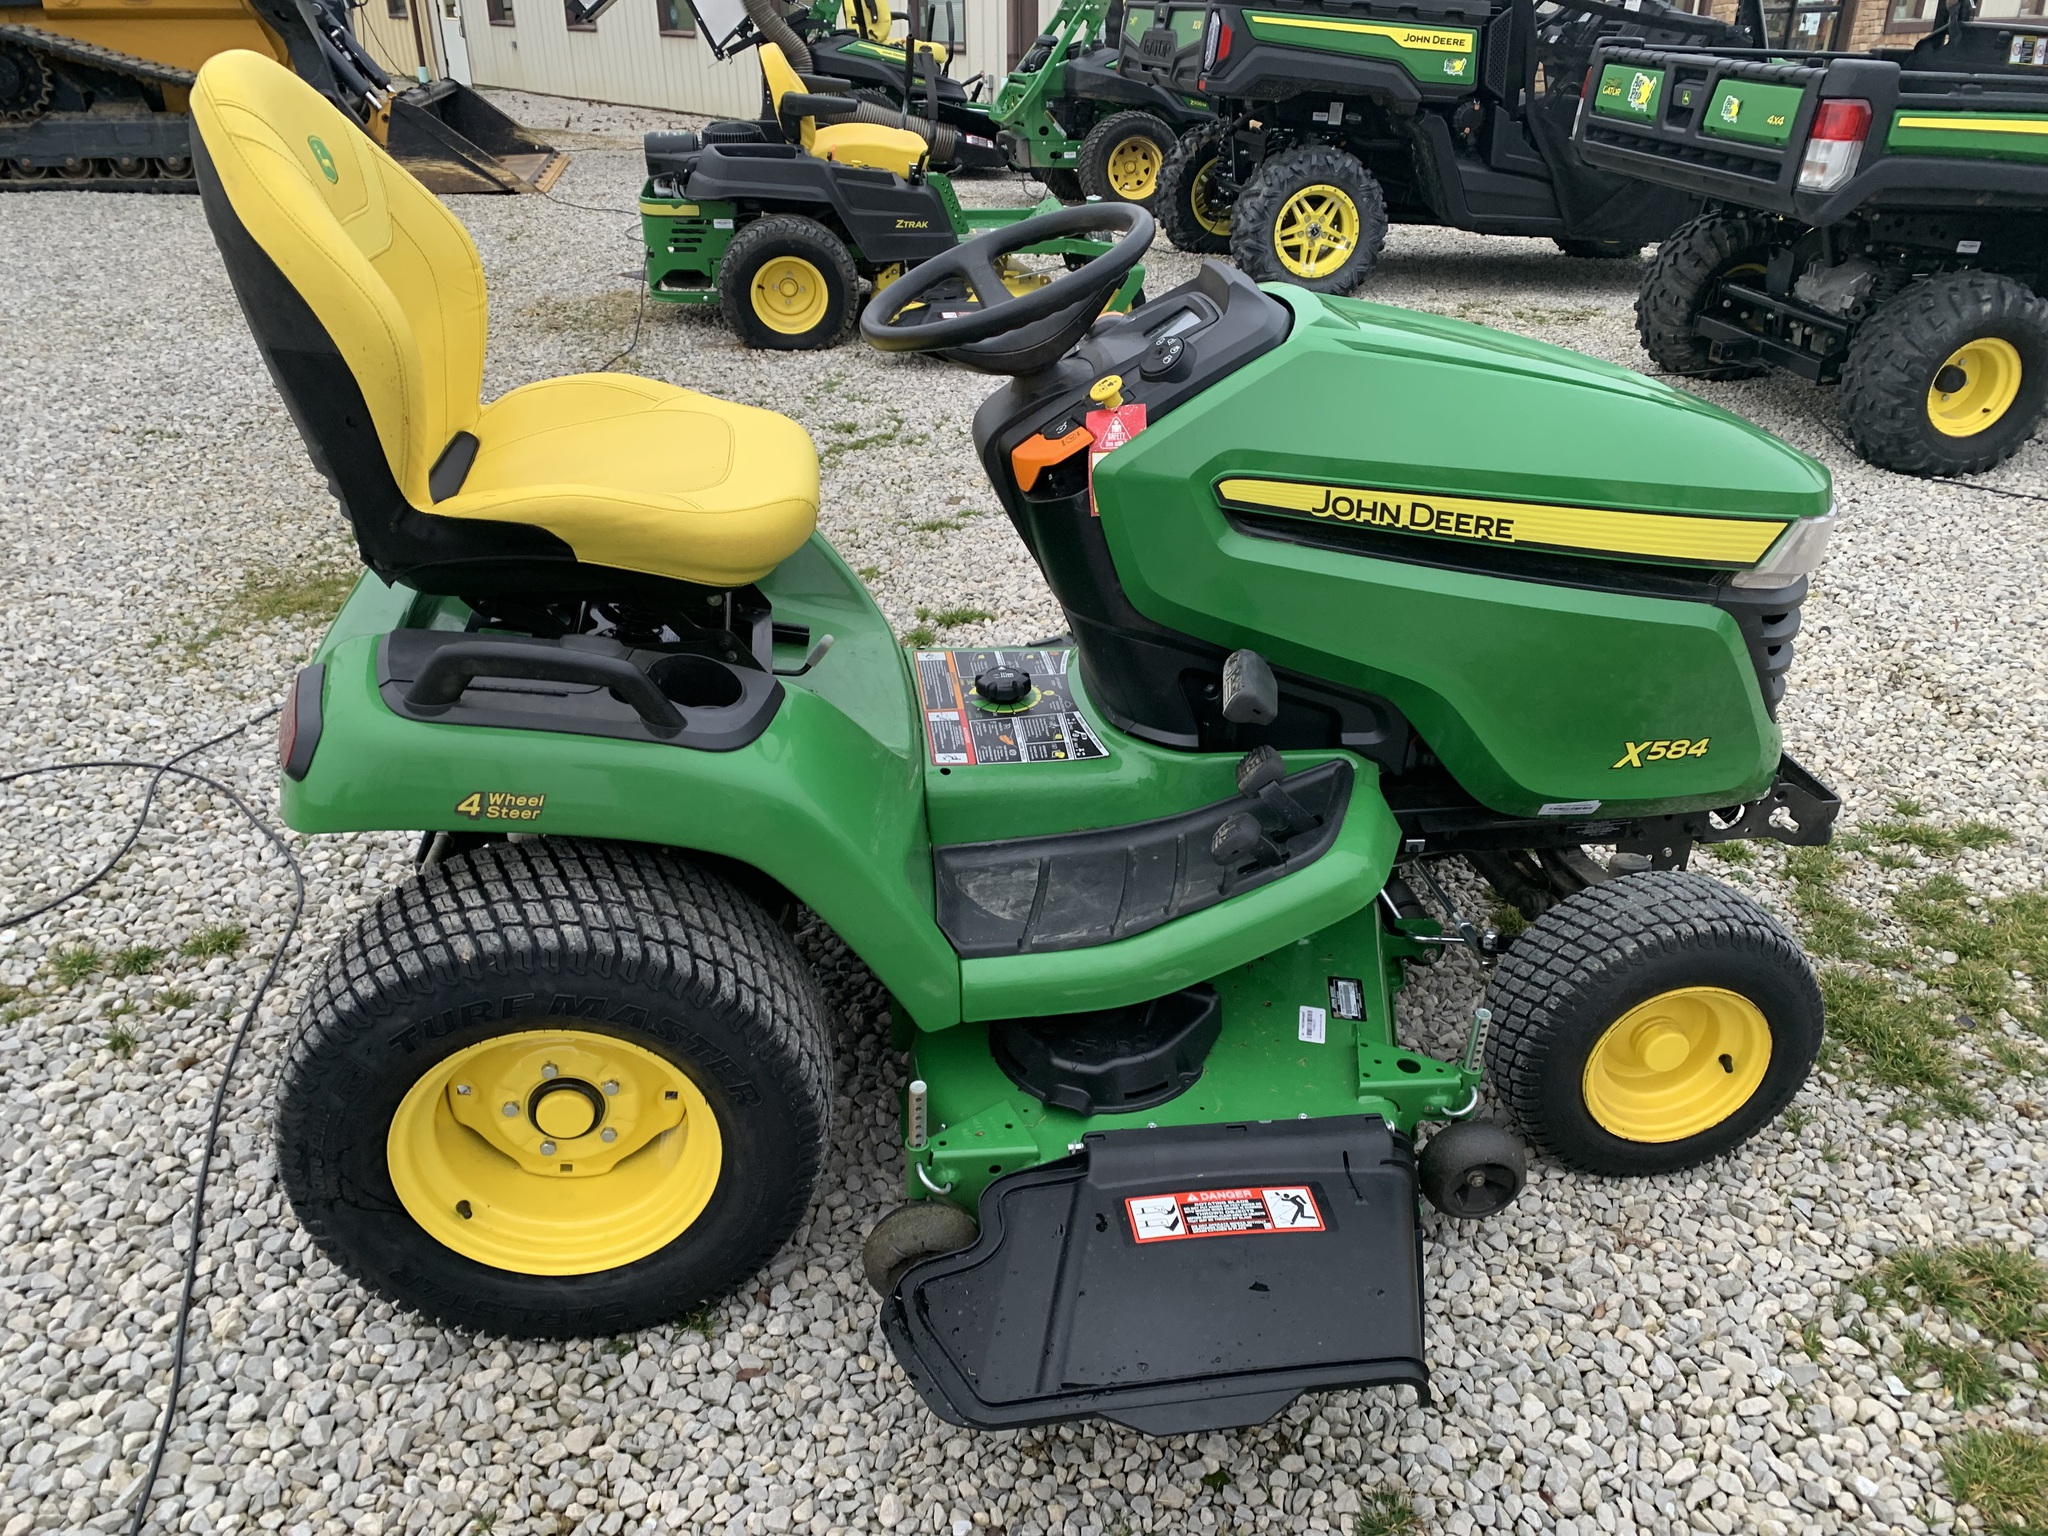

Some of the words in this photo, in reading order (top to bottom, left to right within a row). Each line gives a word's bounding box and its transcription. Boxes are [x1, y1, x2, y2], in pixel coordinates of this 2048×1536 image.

[1403, 33, 1431, 44] JOHN
[1432, 35, 1466, 46] DEERE
[895, 219, 929, 229] ZTRAK
[1311, 489, 1402, 527] JOHN
[1409, 502, 1515, 541] DEERE
[1609, 737, 1711, 769] X584
[456, 792, 482, 817] 4
[488, 792, 545, 807] Wheel
[486, 806, 541, 820] Steer
[387, 992, 535, 1056] TURF
[546, 993, 763, 1109] MASTER
[1199, 1190, 1252, 1201] DANGER
